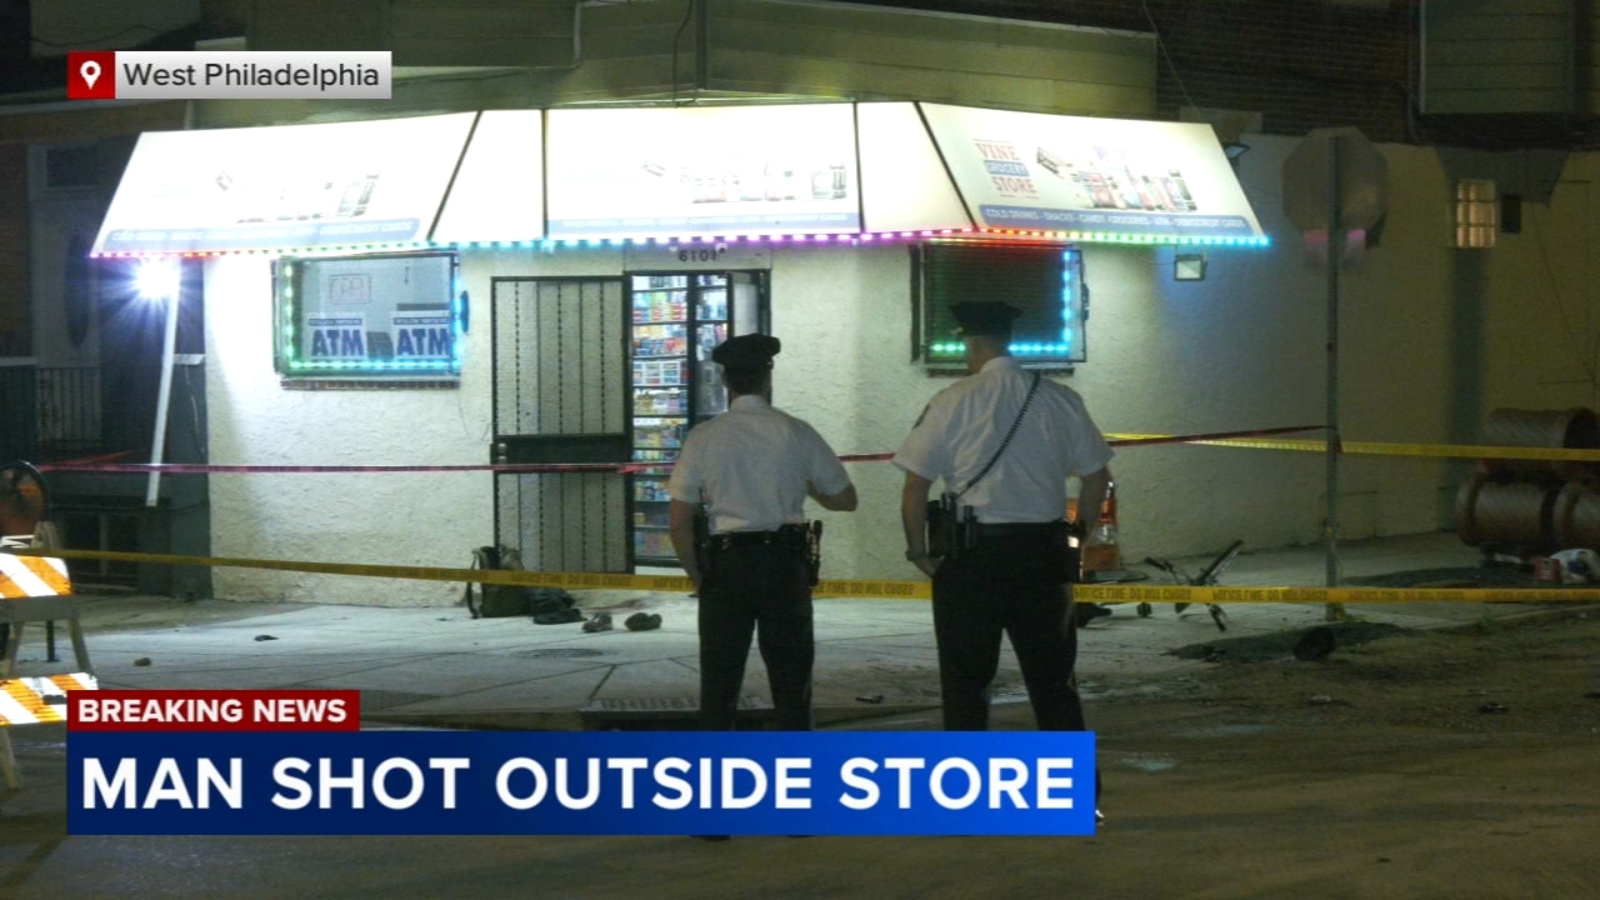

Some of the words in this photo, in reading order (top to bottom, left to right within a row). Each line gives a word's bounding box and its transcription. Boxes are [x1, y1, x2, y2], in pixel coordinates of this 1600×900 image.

[974, 143, 1021, 160] VINE
[991, 176, 1038, 193] STORE
[678, 249, 717, 262] 6101
[311, 329, 364, 356] ATM
[396, 328, 450, 356] ATM
